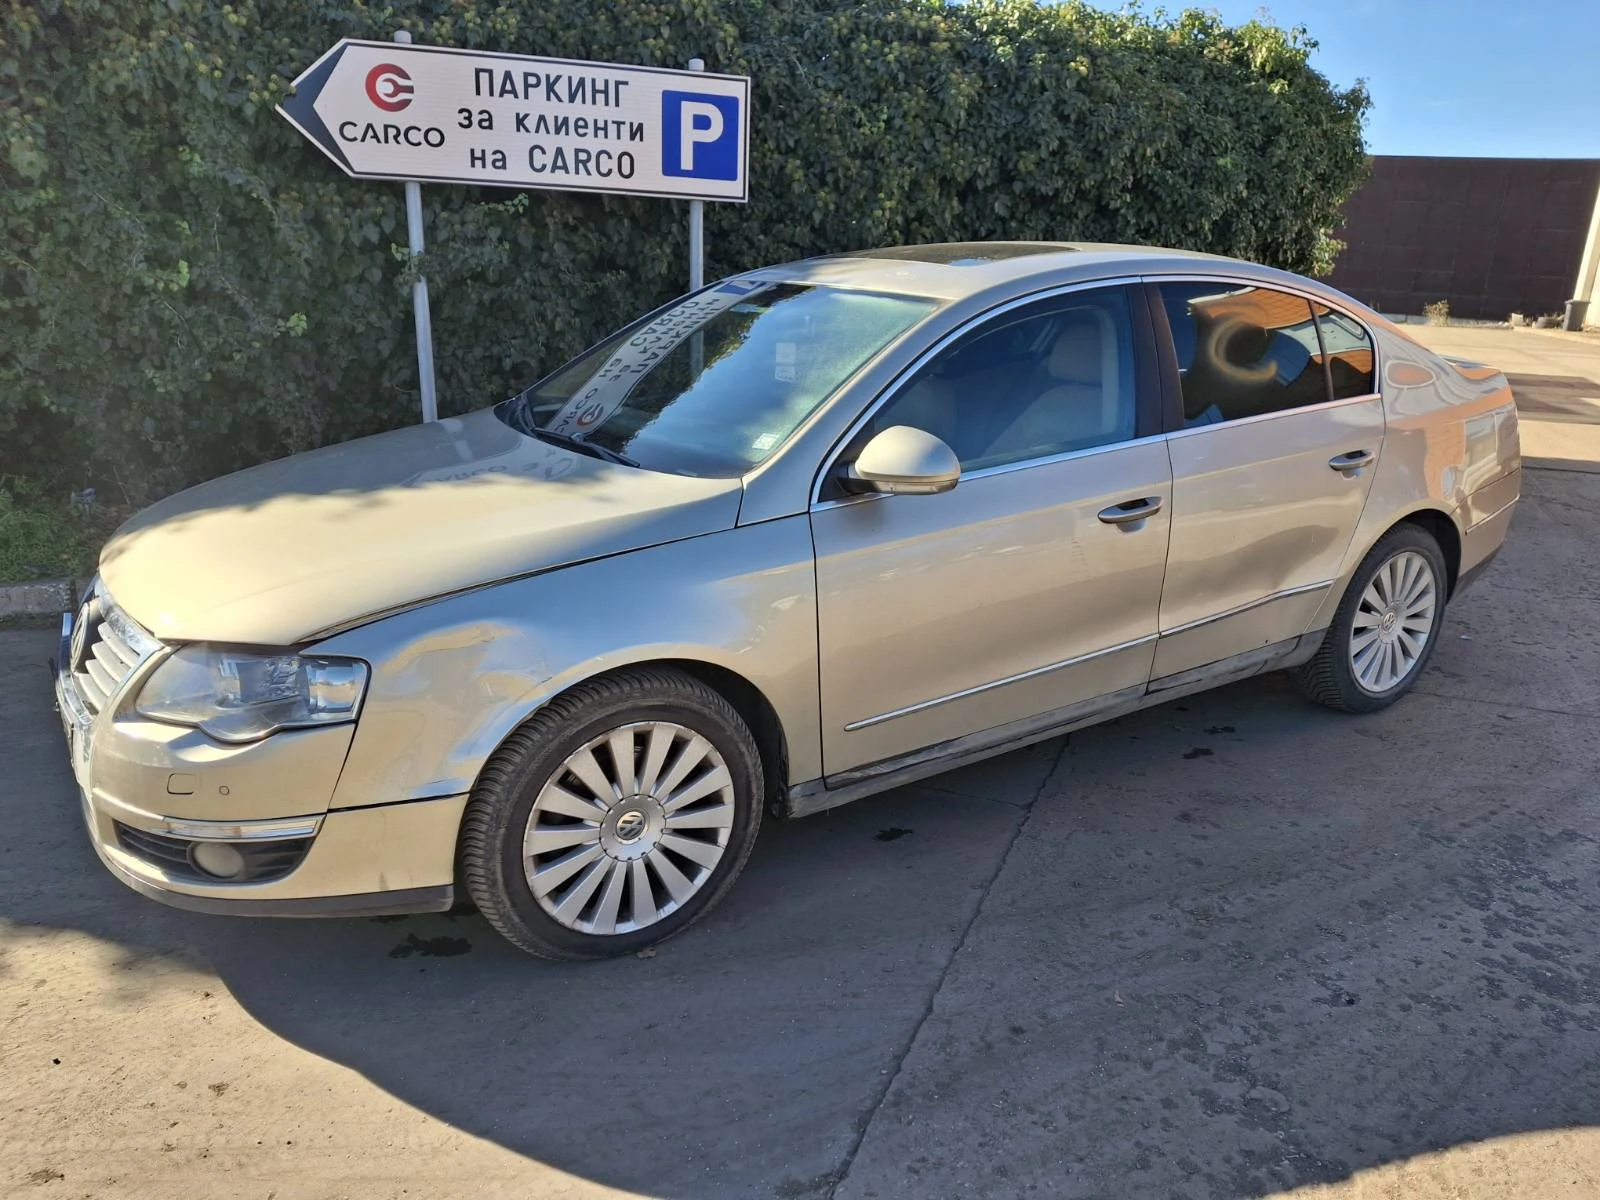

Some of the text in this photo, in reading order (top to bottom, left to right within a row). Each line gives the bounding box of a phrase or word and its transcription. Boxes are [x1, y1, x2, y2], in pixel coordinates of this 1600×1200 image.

[475, 68, 629, 107] ПАРКИНГ
[338, 120, 446, 148] CARCO
[458, 107, 644, 142] за клиенти
[680, 100, 724, 171] P
[470, 145, 635, 179] на CARCO
